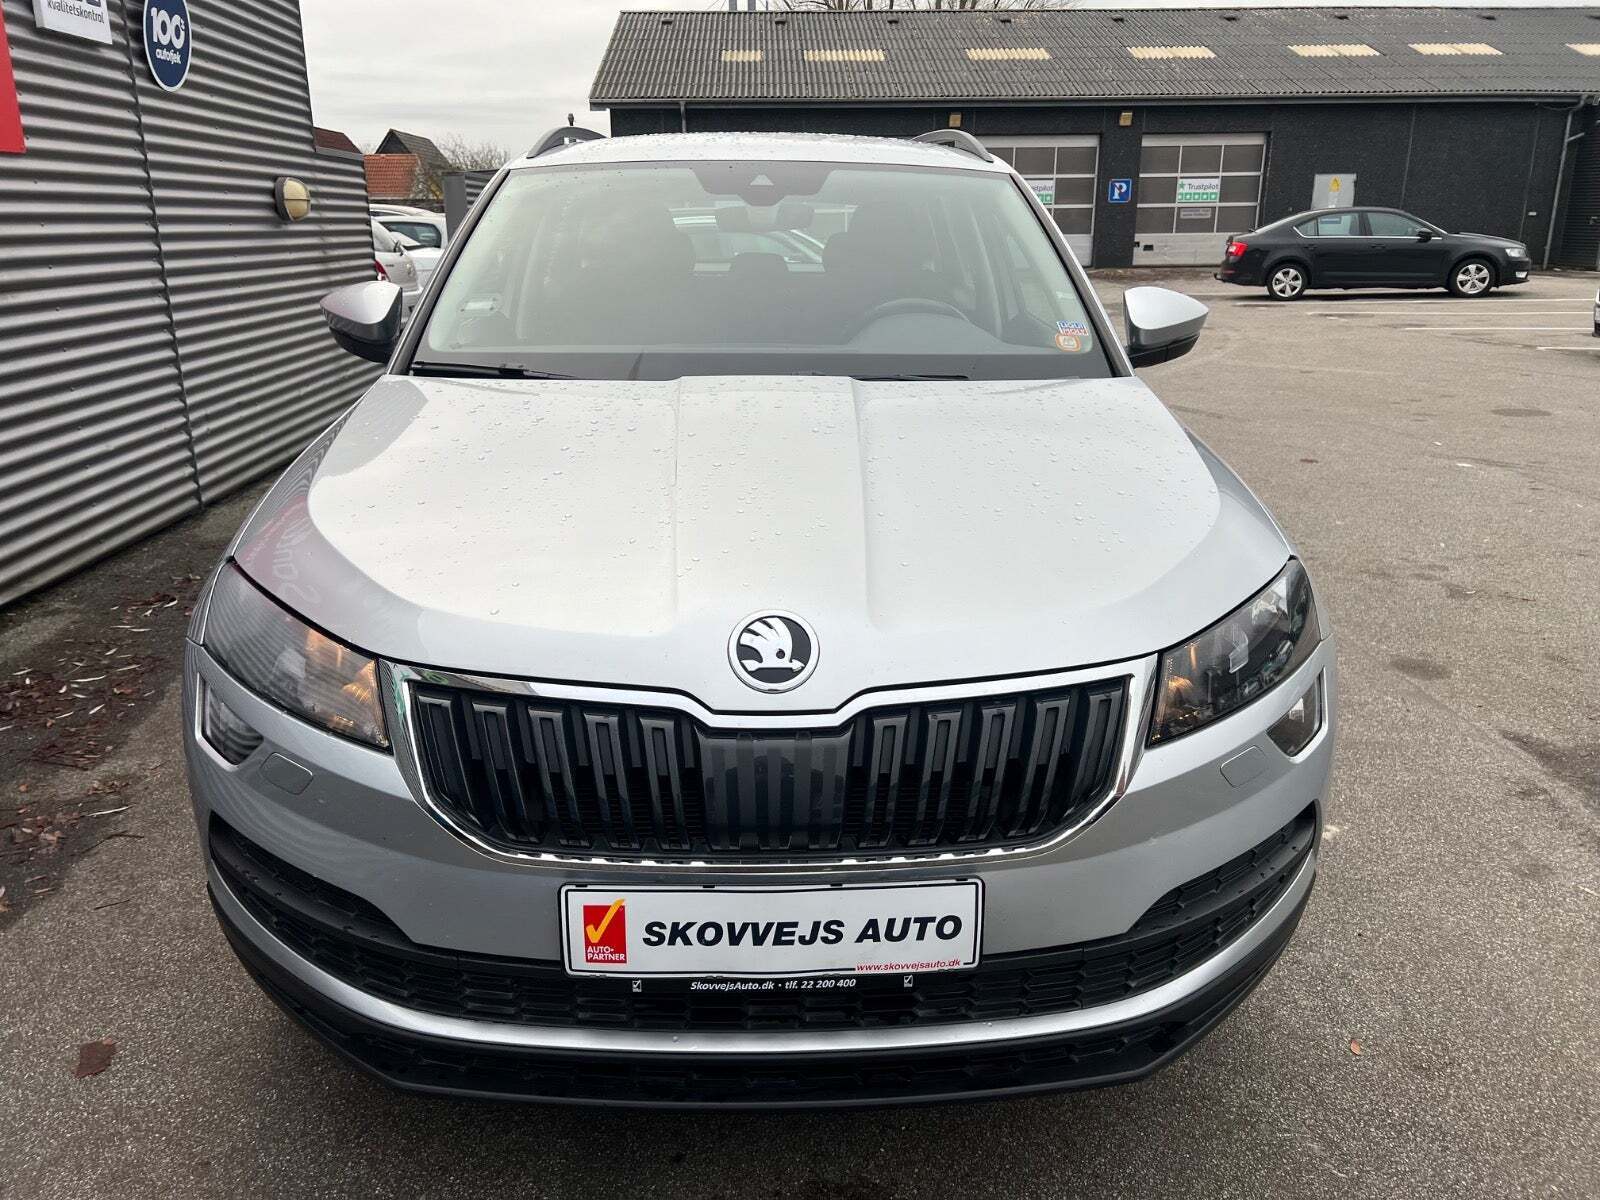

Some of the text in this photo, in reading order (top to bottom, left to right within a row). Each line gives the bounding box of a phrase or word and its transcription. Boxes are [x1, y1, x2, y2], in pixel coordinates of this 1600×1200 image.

[47, 0, 104, 23] kvalitetskontrol
[642, 915, 962, 947] SKOVVEJS AUTO
[587, 946, 615, 954] AUTO-
[587, 953, 626, 961] PARTNER
[856, 959, 961, 971] www.skovvejsauto.dk
[690, 978, 856, 992] SkovvejsAuto.dk tlf. 22 200 400
